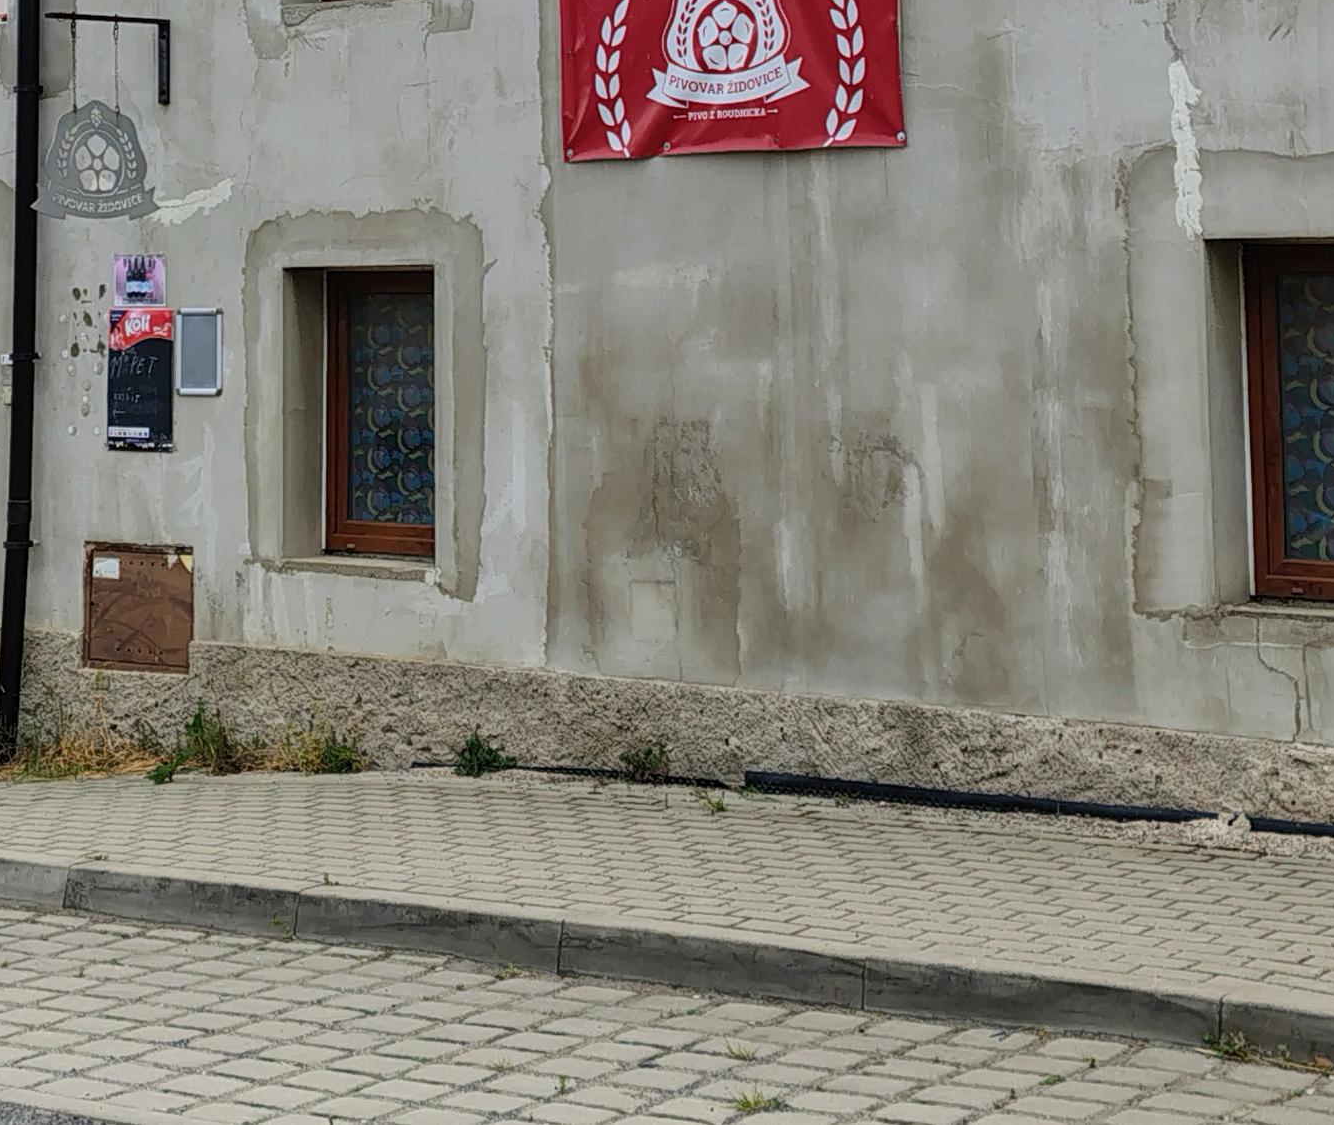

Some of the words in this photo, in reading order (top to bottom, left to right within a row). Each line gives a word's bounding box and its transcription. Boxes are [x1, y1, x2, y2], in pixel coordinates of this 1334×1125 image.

[669, 74, 724, 95] PIVOVAR
[727, 66, 784, 95] ŽIDOVICE
[687, 110, 708, 121] PIVO
[51, 193, 96, 213] PIVOVAR
